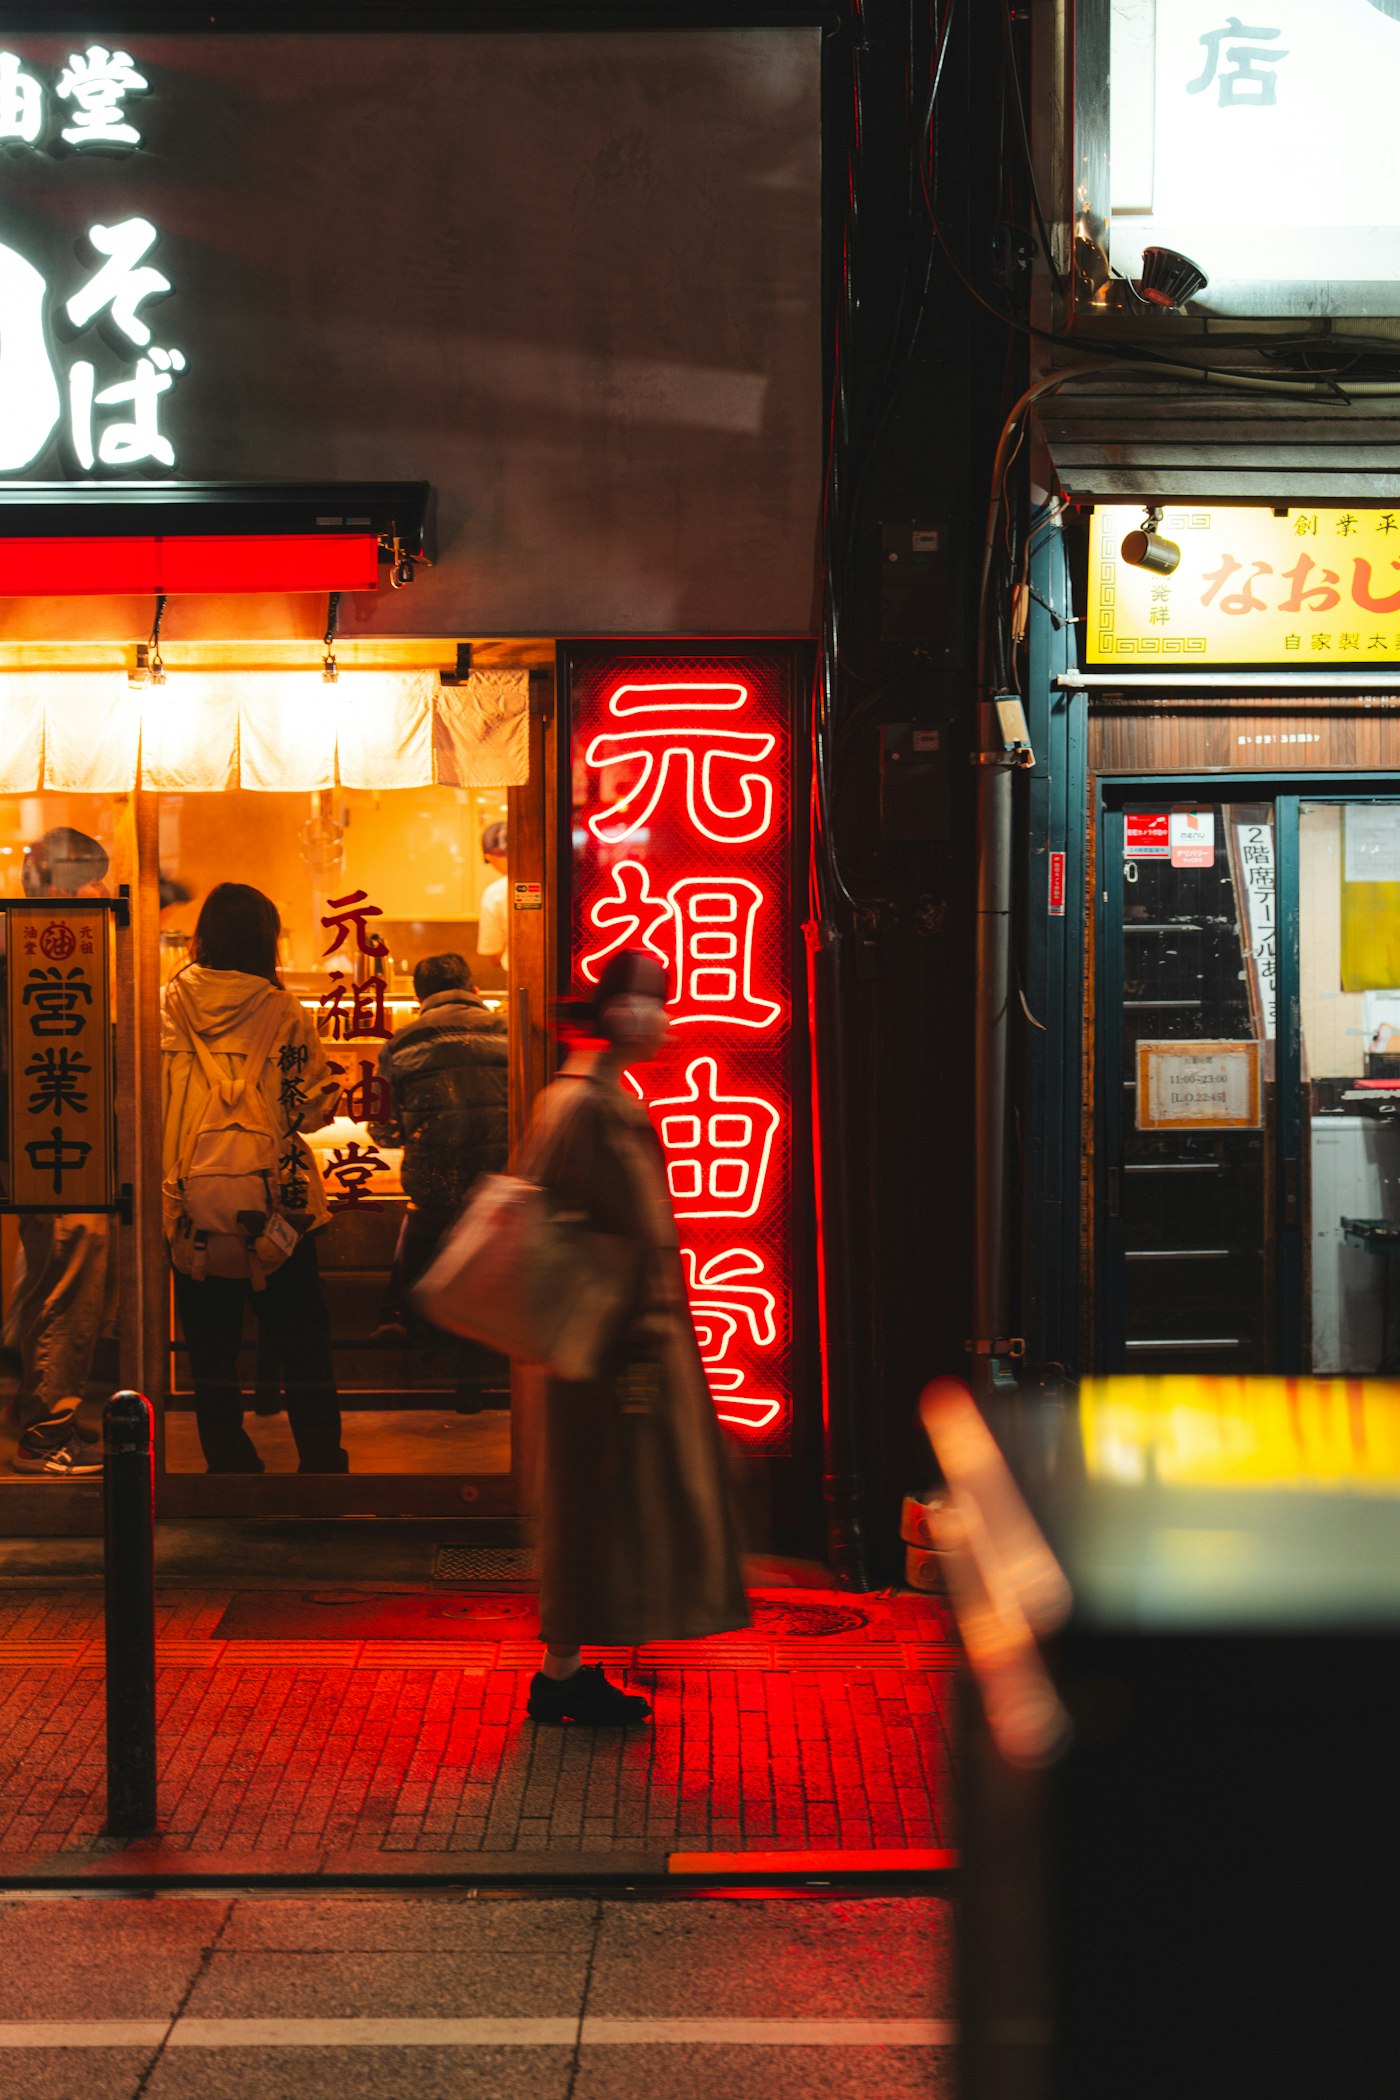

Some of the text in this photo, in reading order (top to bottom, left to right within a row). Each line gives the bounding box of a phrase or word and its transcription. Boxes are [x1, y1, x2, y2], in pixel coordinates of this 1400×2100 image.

[1186, 16, 1290, 108] 店
[66, 217, 186, 471] そば
[1284, 633, 1400, 651] 自家製太
[22, 966, 93, 1195] 営業中
[277, 1044, 310, 1211] 御茶ノ水店
[318, 890, 394, 1214] 元祖油堂
